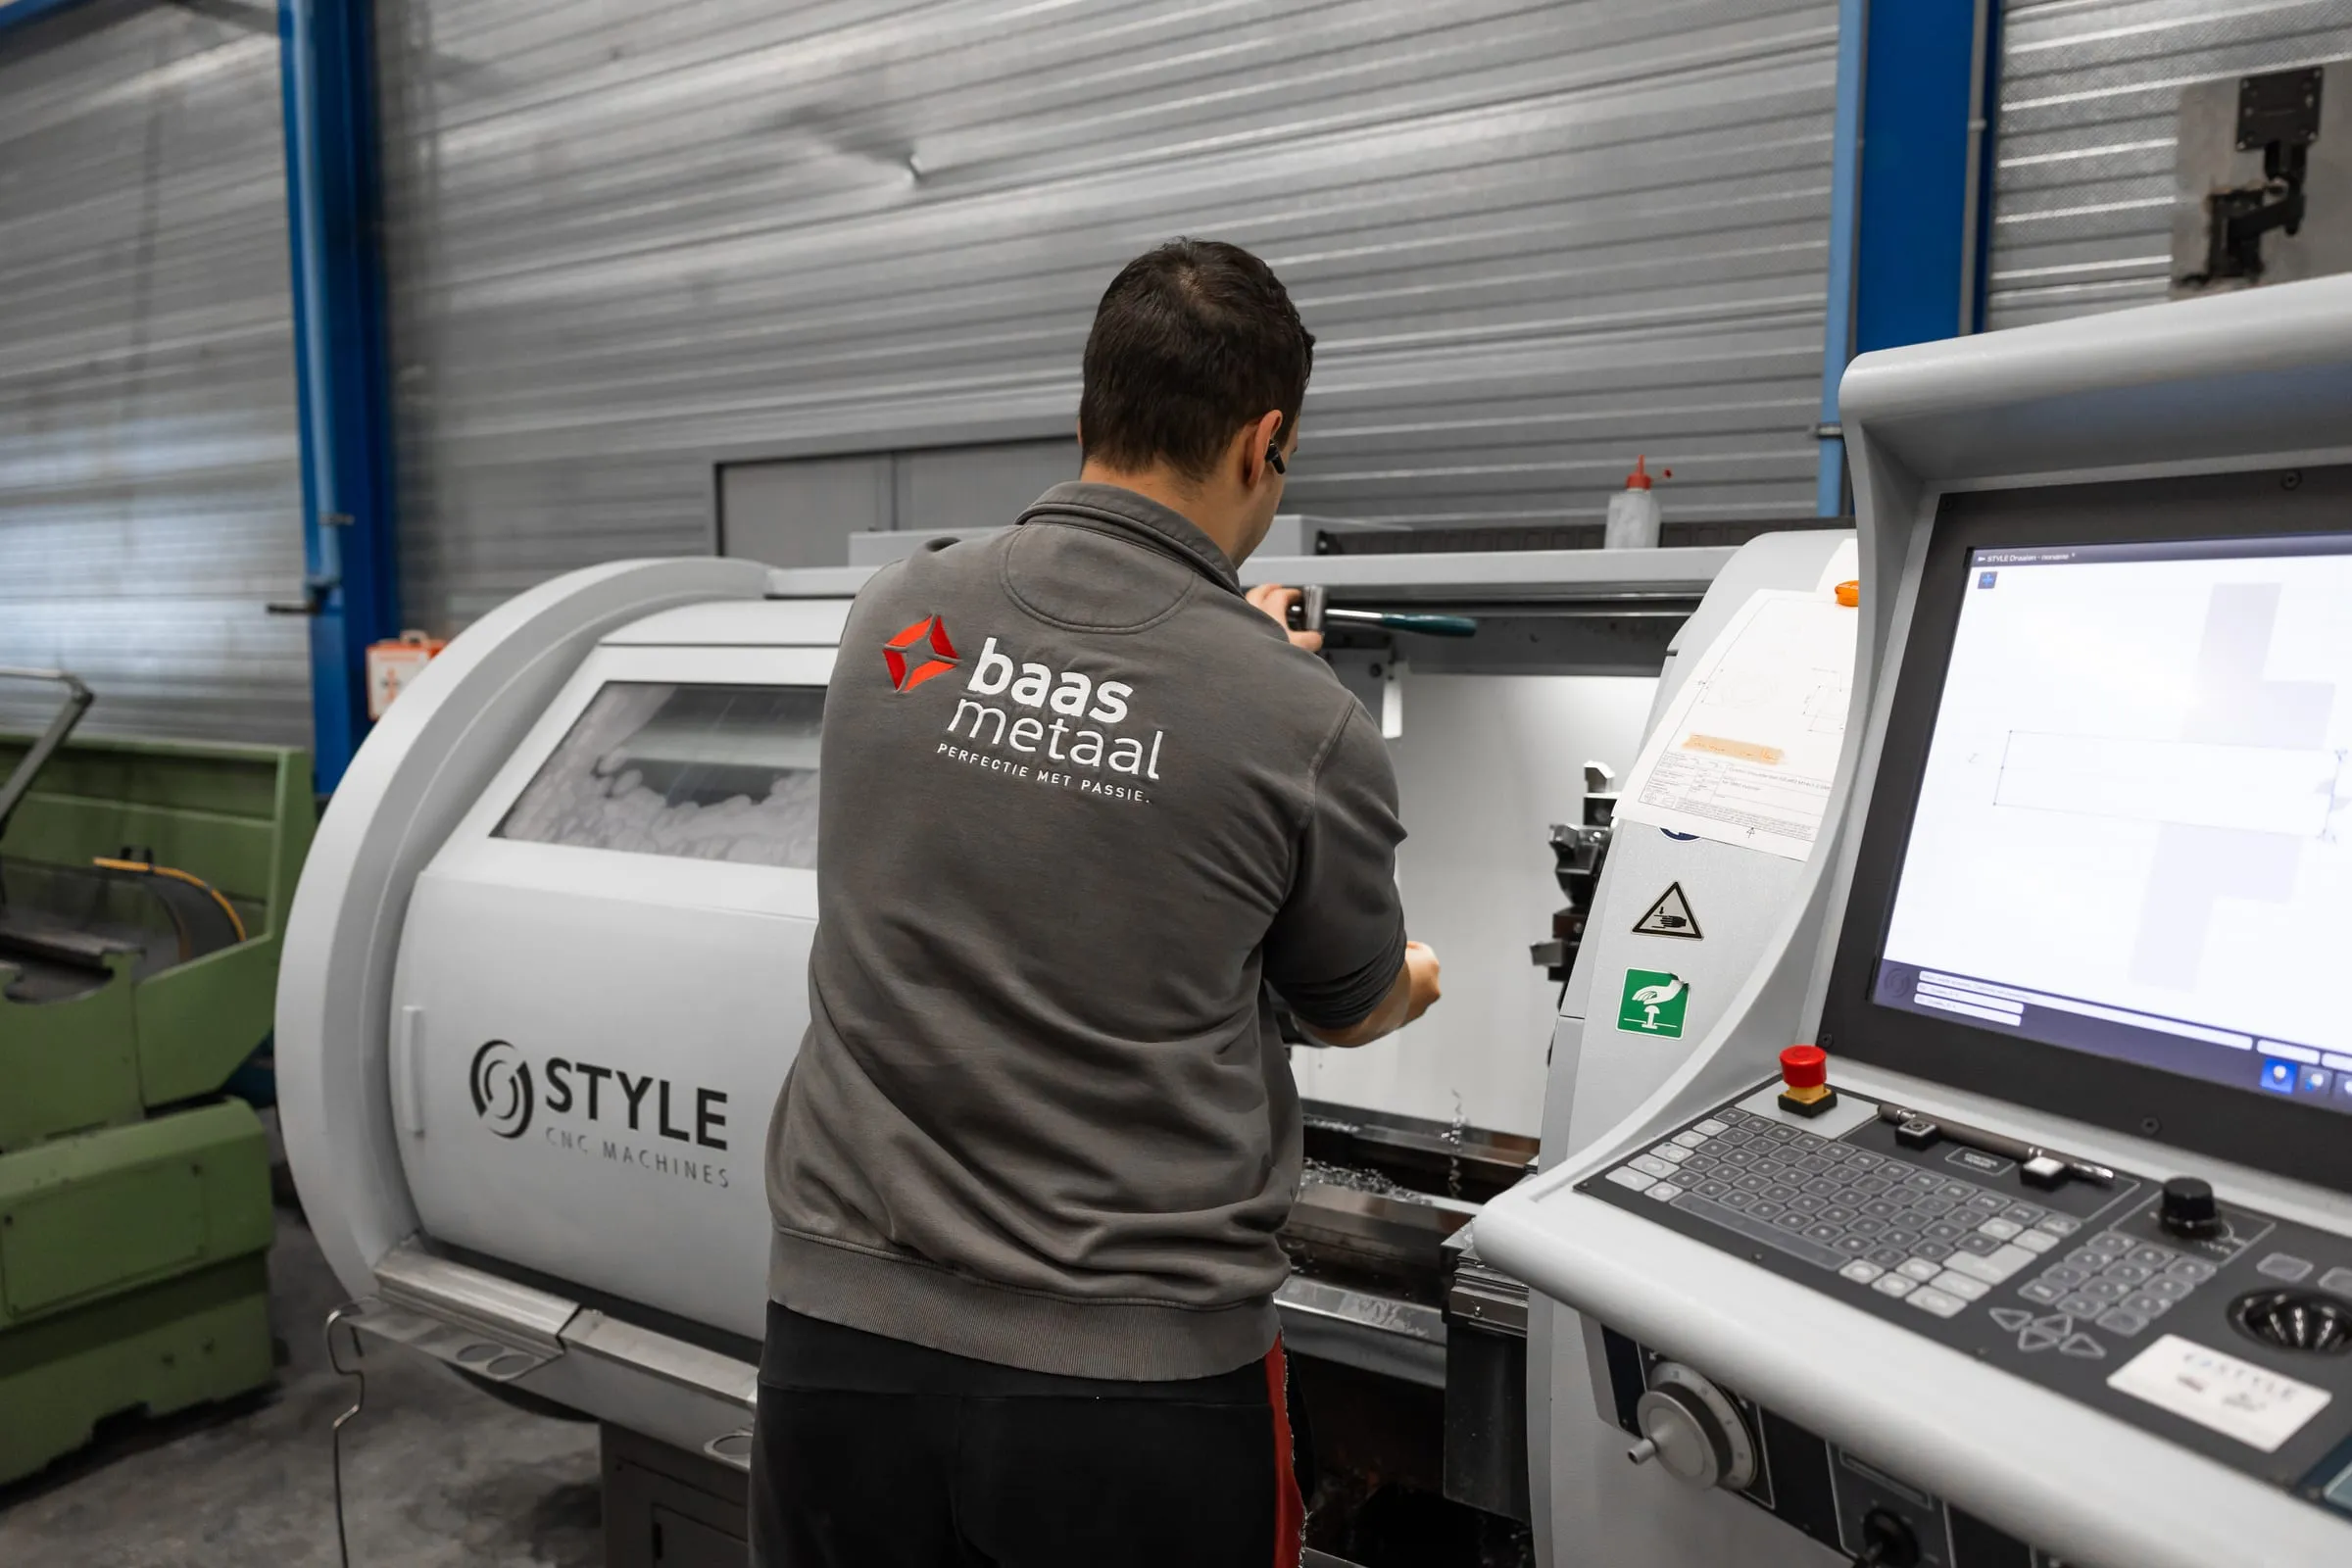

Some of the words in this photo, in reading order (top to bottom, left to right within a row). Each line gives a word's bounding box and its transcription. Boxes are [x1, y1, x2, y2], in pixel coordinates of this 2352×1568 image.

[966, 637, 1134, 723] baas
[937, 743, 1029, 777] PERFECTIE
[1037, 770, 1071, 787] MET
[1080, 779, 1151, 804] PASSIE.
[947, 698, 1164, 780] metaal
[545, 1056, 728, 1152] STYLE
[545, 1127, 589, 1154] CNC
[602, 1140, 729, 1189] MACHINES
